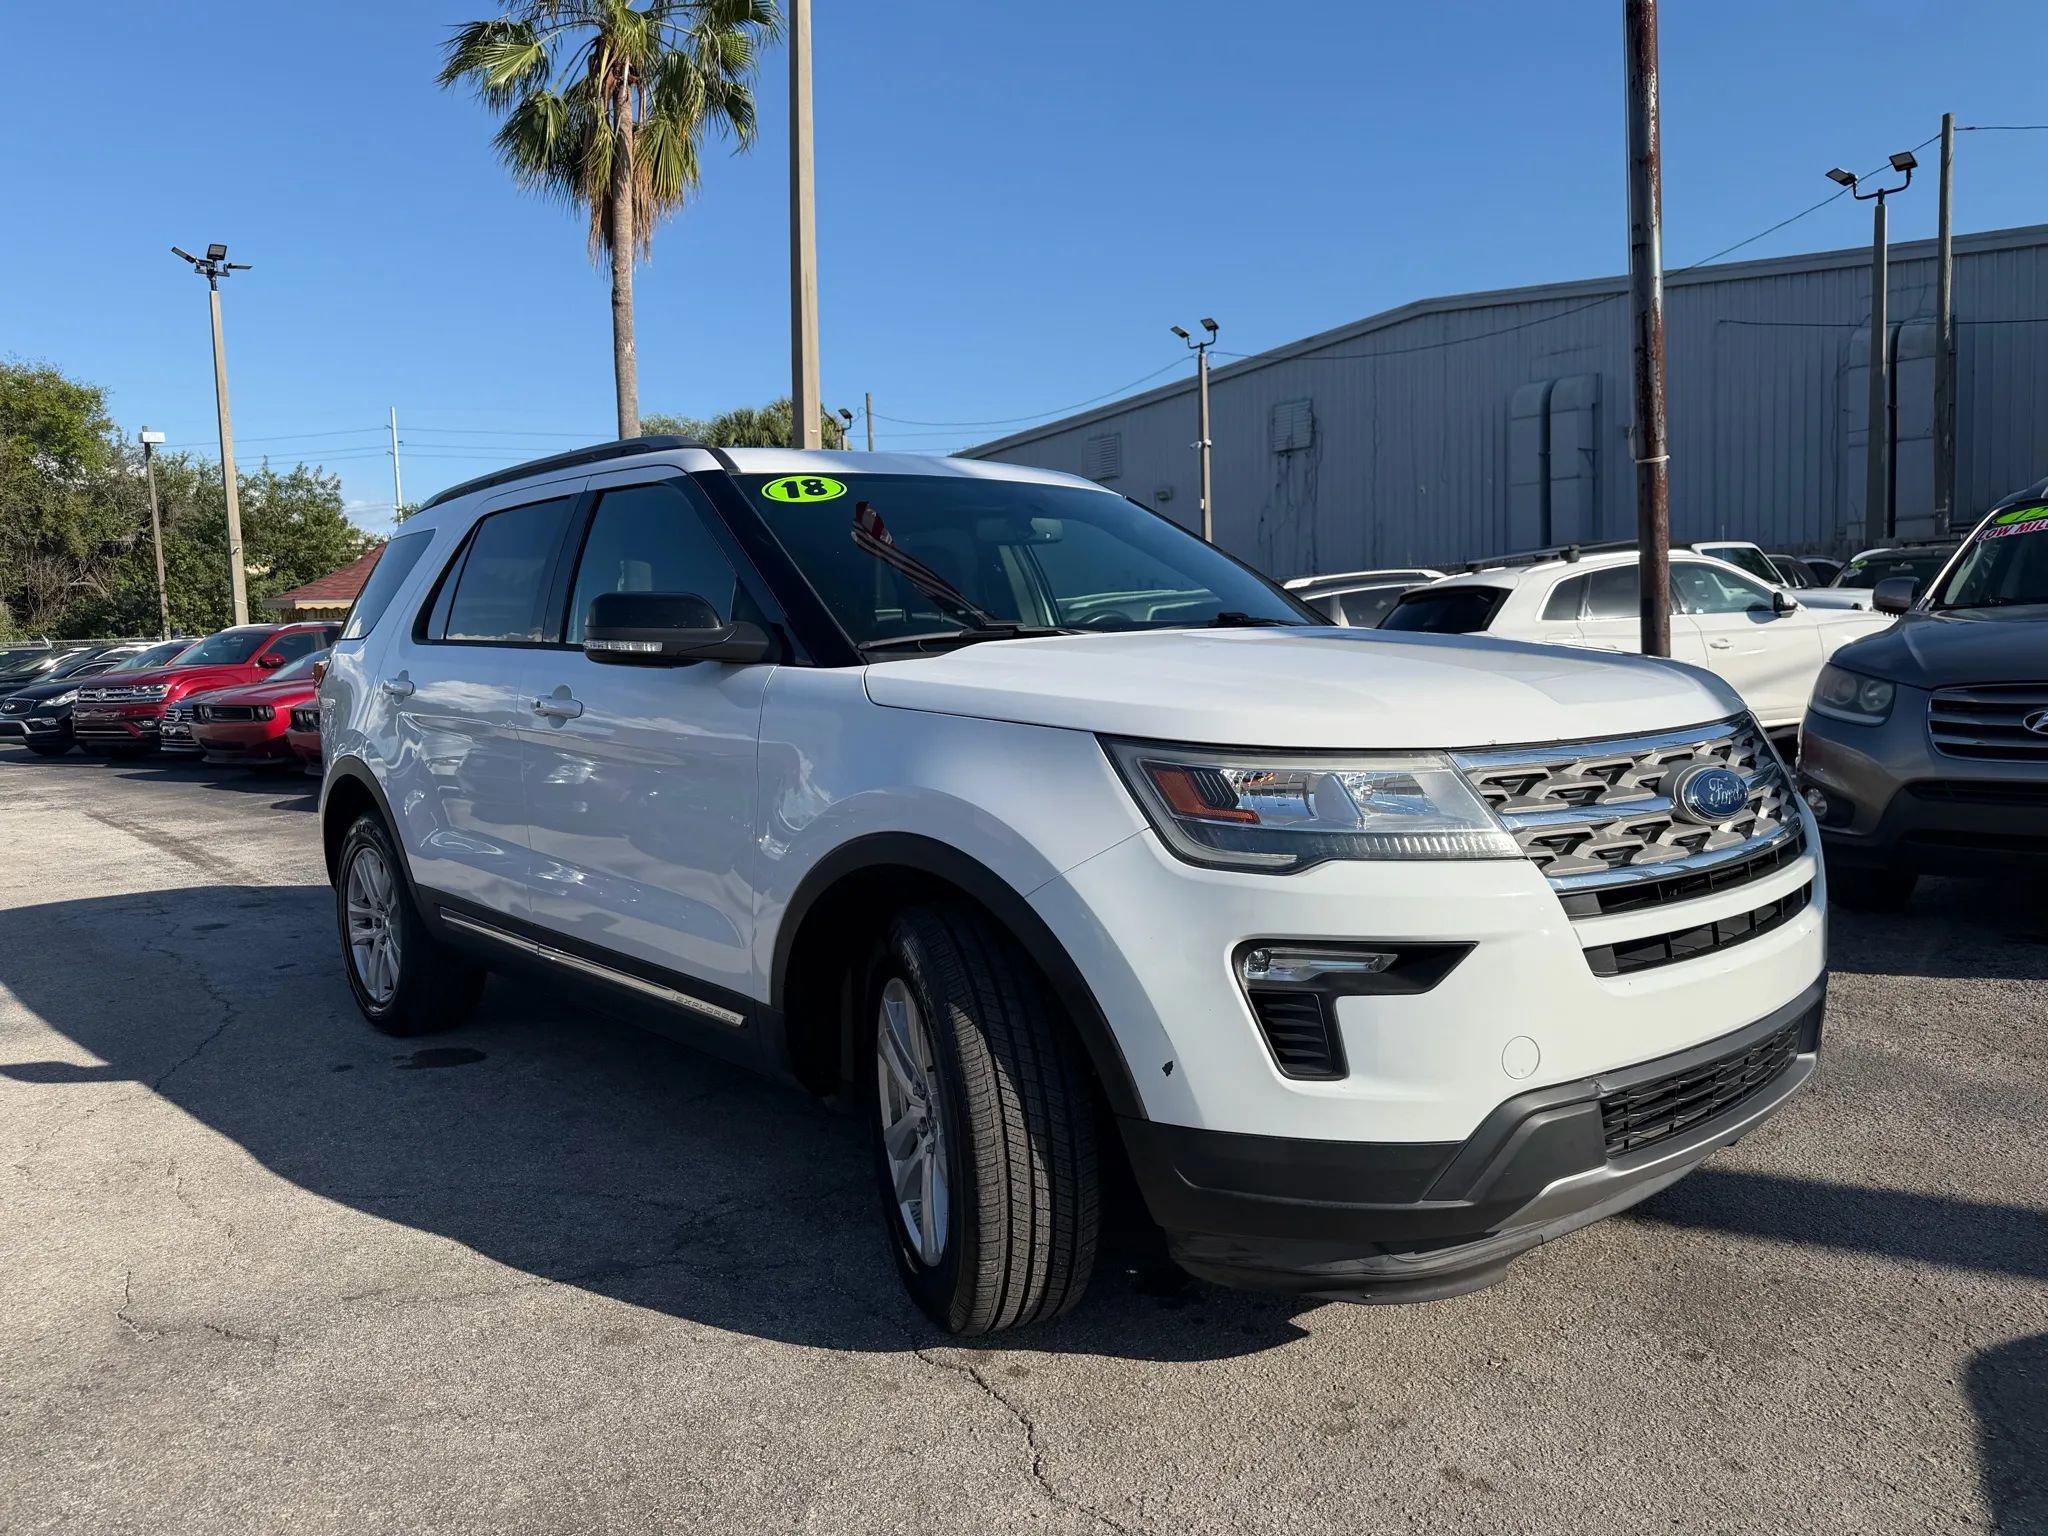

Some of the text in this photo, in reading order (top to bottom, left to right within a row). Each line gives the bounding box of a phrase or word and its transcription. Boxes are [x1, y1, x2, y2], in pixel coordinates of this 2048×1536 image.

[780, 479, 828, 499] 18
[1976, 519, 2048, 541] LOW MIL
[1708, 777, 1743, 808] Ford
[676, 995, 738, 1022] EXPLORER
